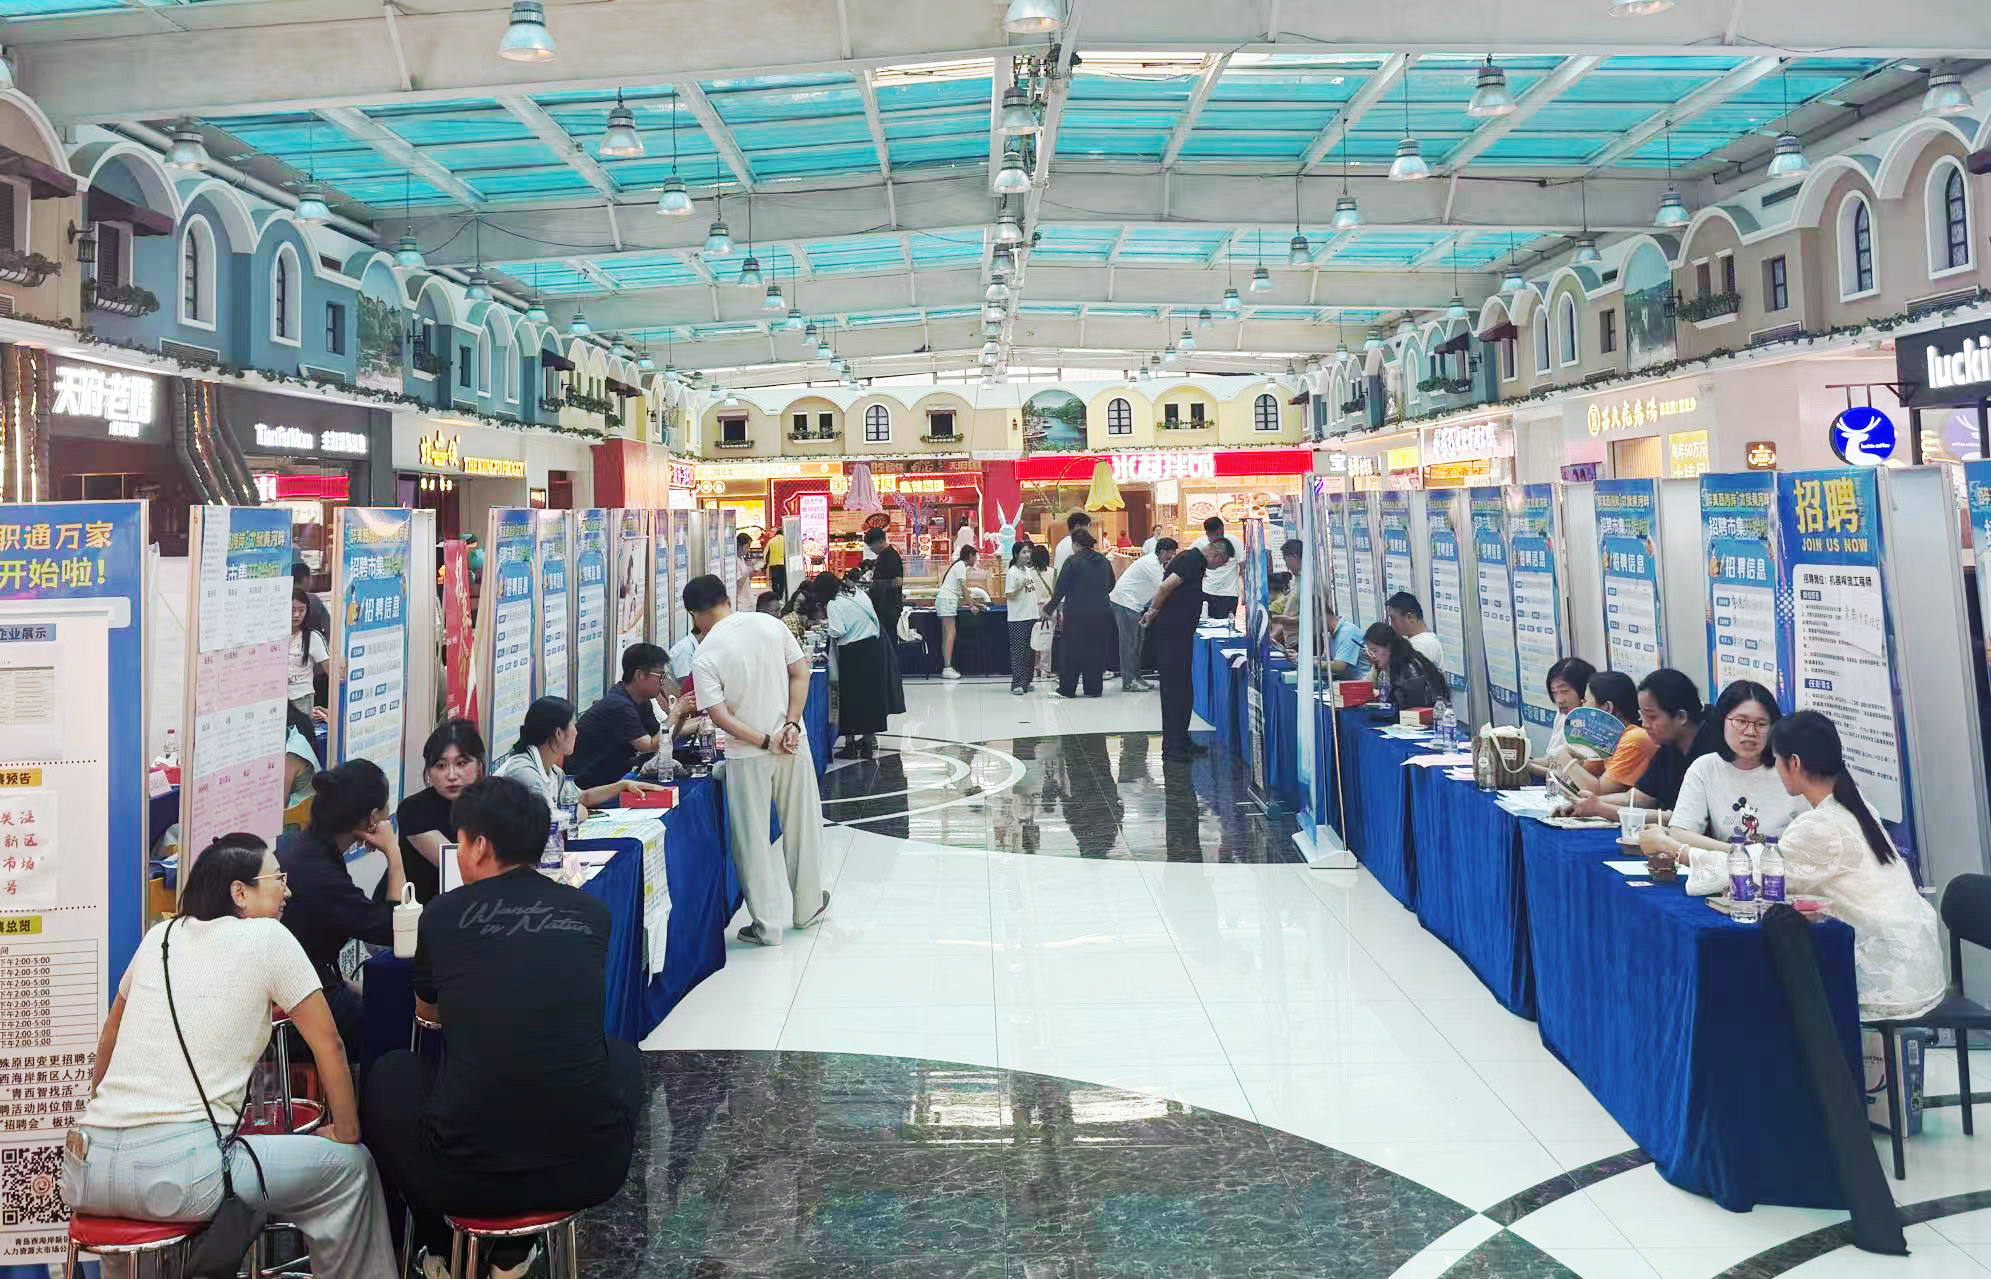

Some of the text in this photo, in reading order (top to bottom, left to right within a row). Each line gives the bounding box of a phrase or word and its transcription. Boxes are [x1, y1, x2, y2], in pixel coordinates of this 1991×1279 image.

[1926, 335, 1991, 388] lucki
[1112, 453, 1216, 481] 米村拌饭
[1794, 476, 1858, 534] 招聘
[0, 520, 113, 551] 职通万家
[1802, 538, 1868, 552] JOIN US NOW
[1726, 555, 1766, 580] 招聘信息
[4, 833, 38, 848] 新区
[3, 856, 35, 872] 市场
[3, 880, 17, 895] 号
